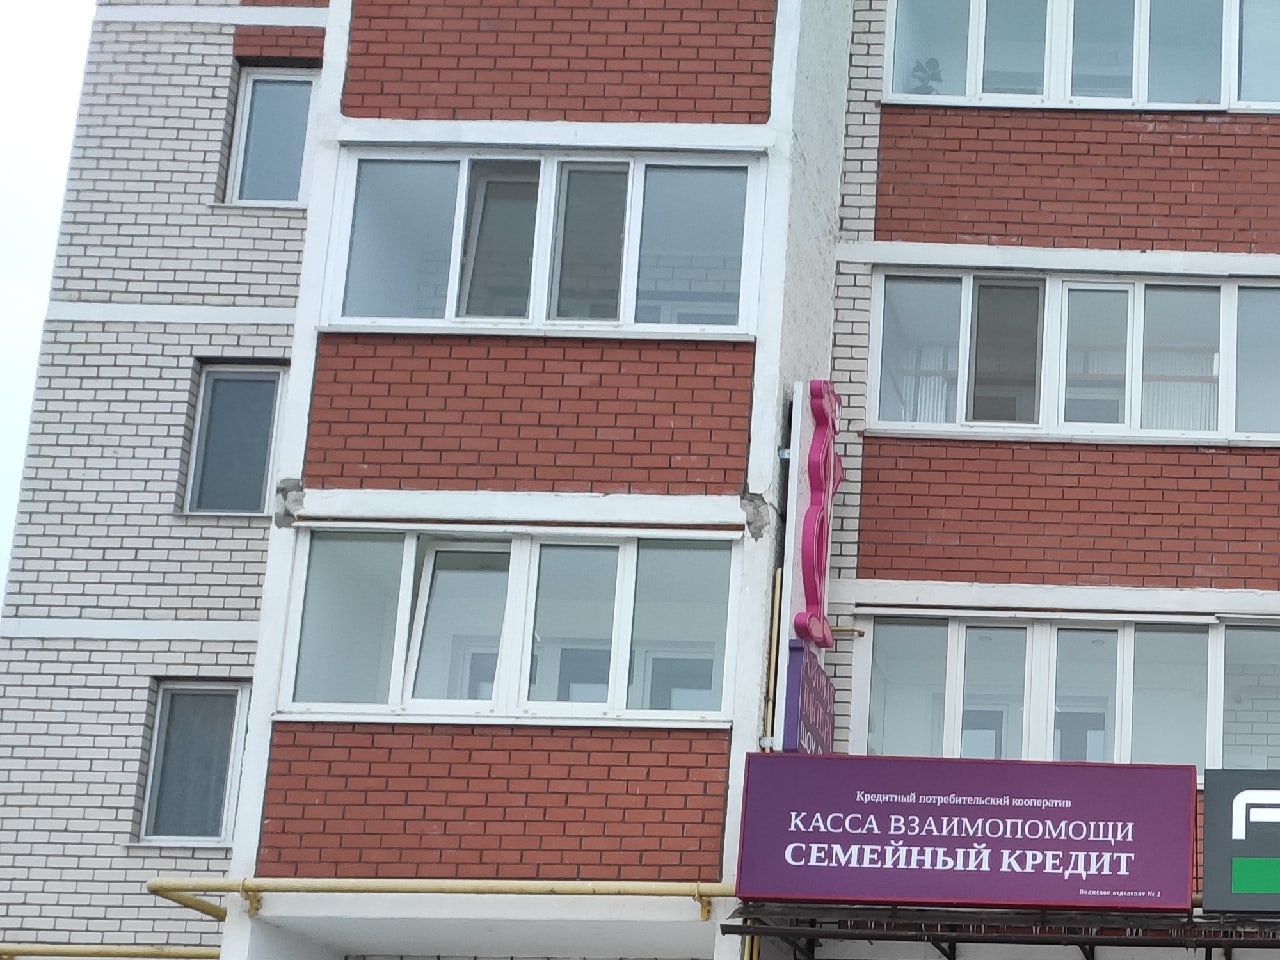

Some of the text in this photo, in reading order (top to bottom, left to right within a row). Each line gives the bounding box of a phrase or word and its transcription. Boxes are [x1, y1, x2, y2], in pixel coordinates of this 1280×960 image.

[856, 790, 1072, 809] Кредитный потребительский кооператив
[788, 812, 1134, 846] КАССА ВЗАИМОПОМОЩИ
[784, 841, 1135, 880] СЕМЕЙНЫЙ КРЕДИТ
